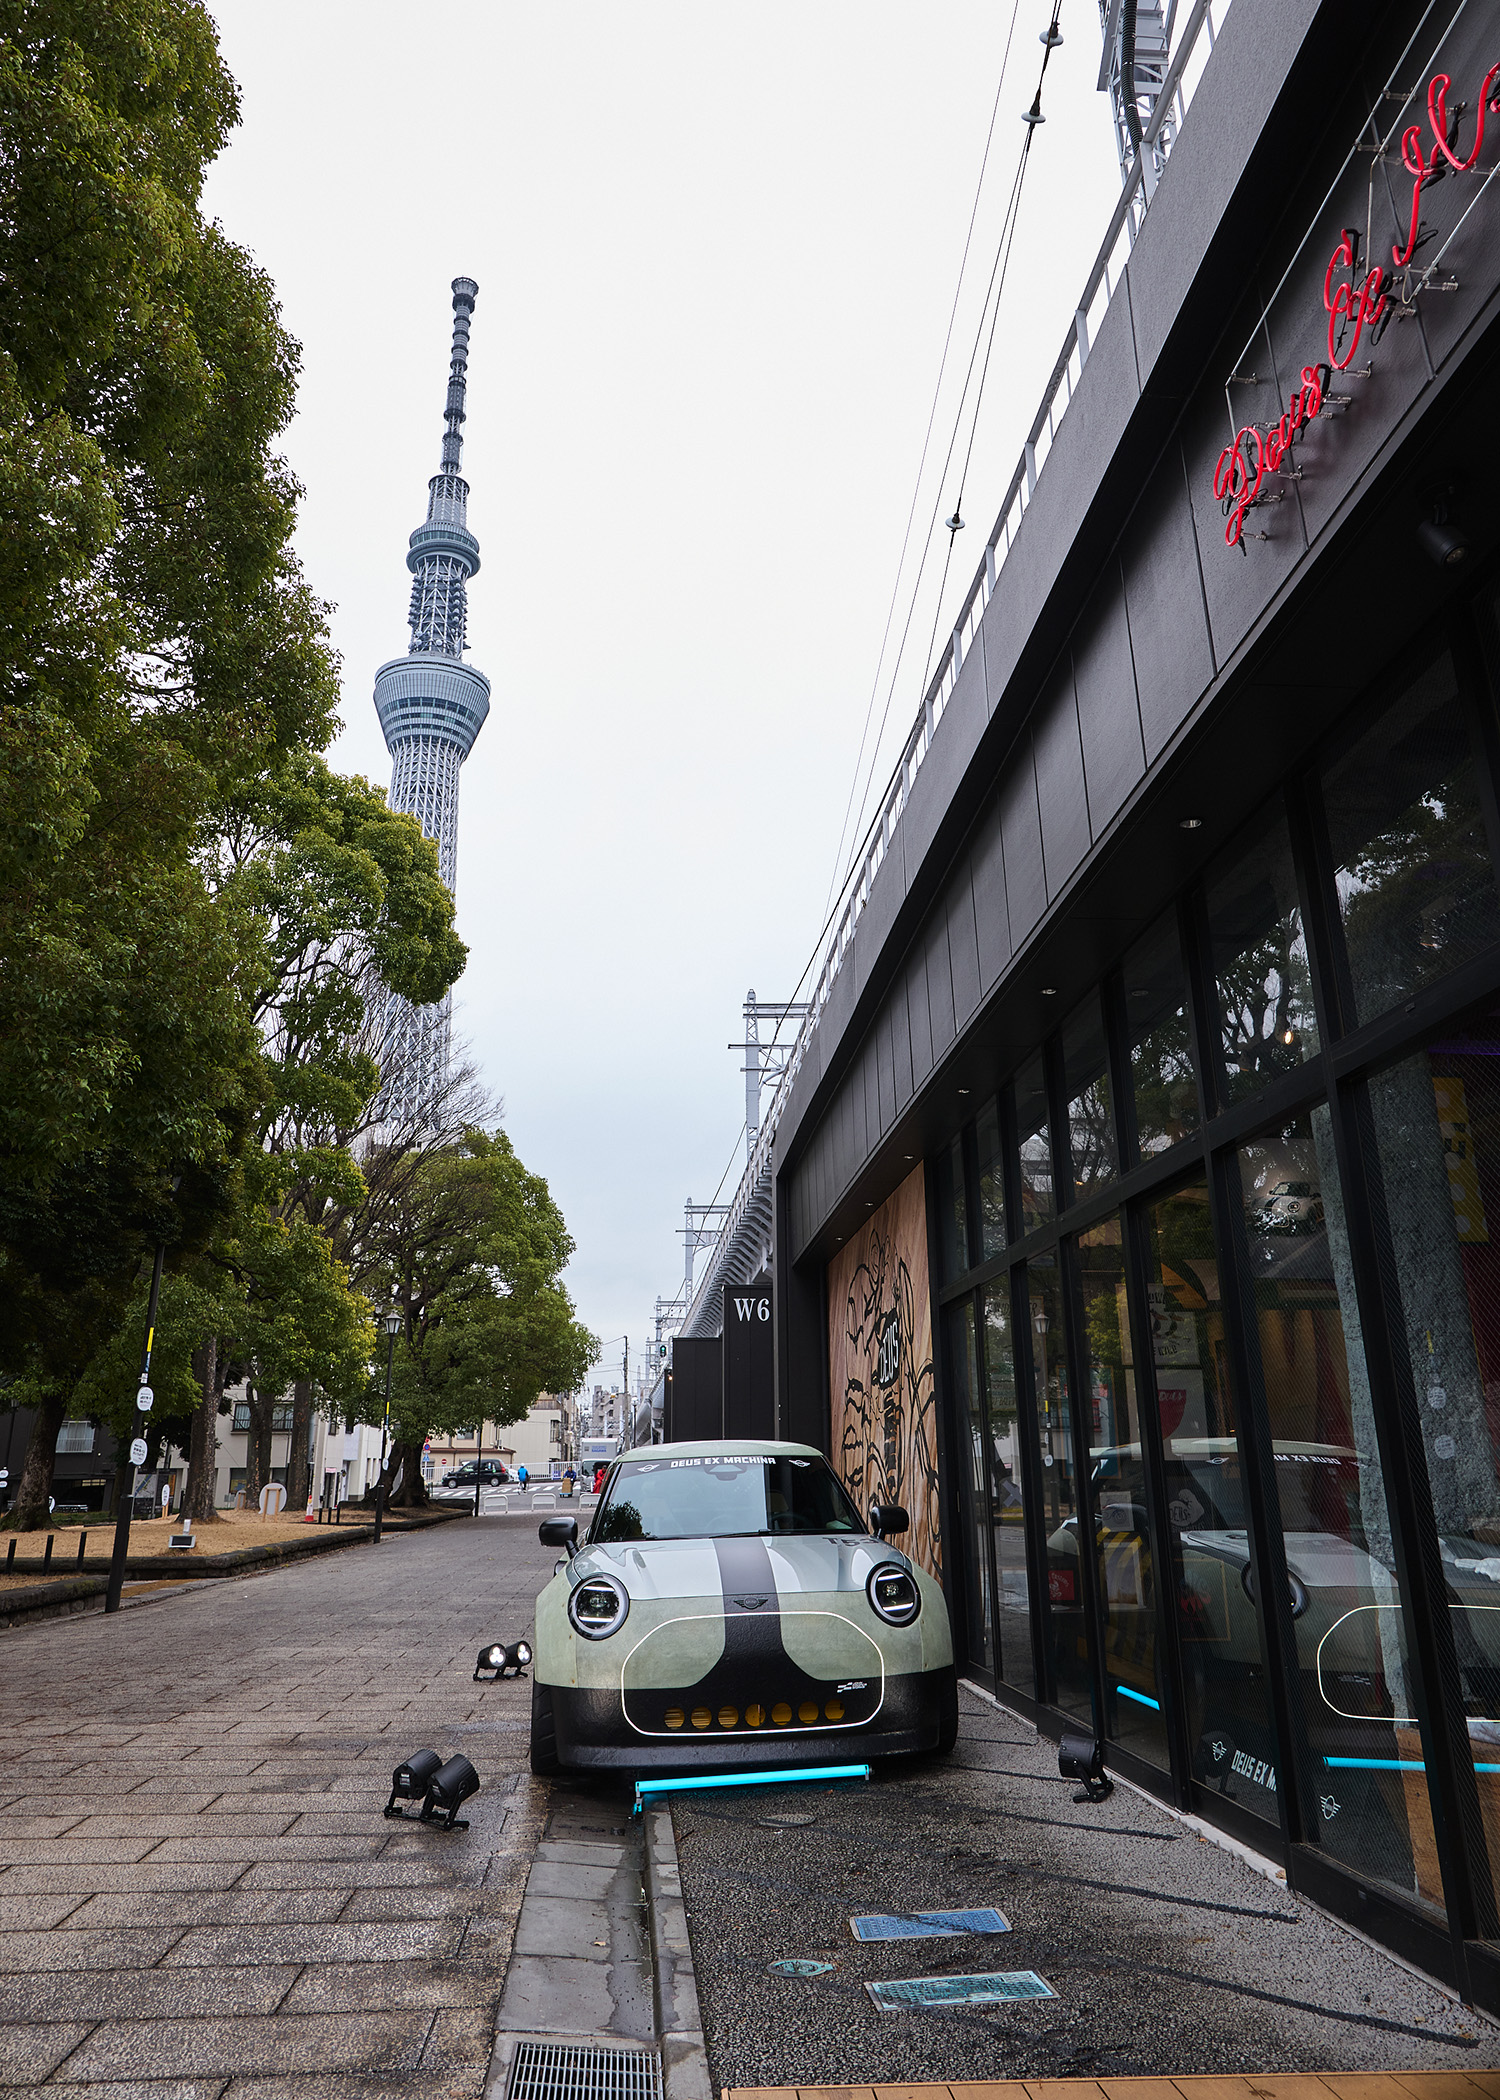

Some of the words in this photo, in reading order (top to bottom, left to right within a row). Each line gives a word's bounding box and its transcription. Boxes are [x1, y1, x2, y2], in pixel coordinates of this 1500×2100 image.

[1213, 362, 1322, 547] Deus
[733, 1297, 771, 1322] W6
[670, 1458, 701, 1469] DEUS
[704, 1457, 720, 1466] EX
[723, 1456, 776, 1465] MACHINA
[1230, 1749, 1256, 1779] DEUS
[1252, 1760, 1269, 1786] EX
[1265, 1766, 1277, 1792] M
